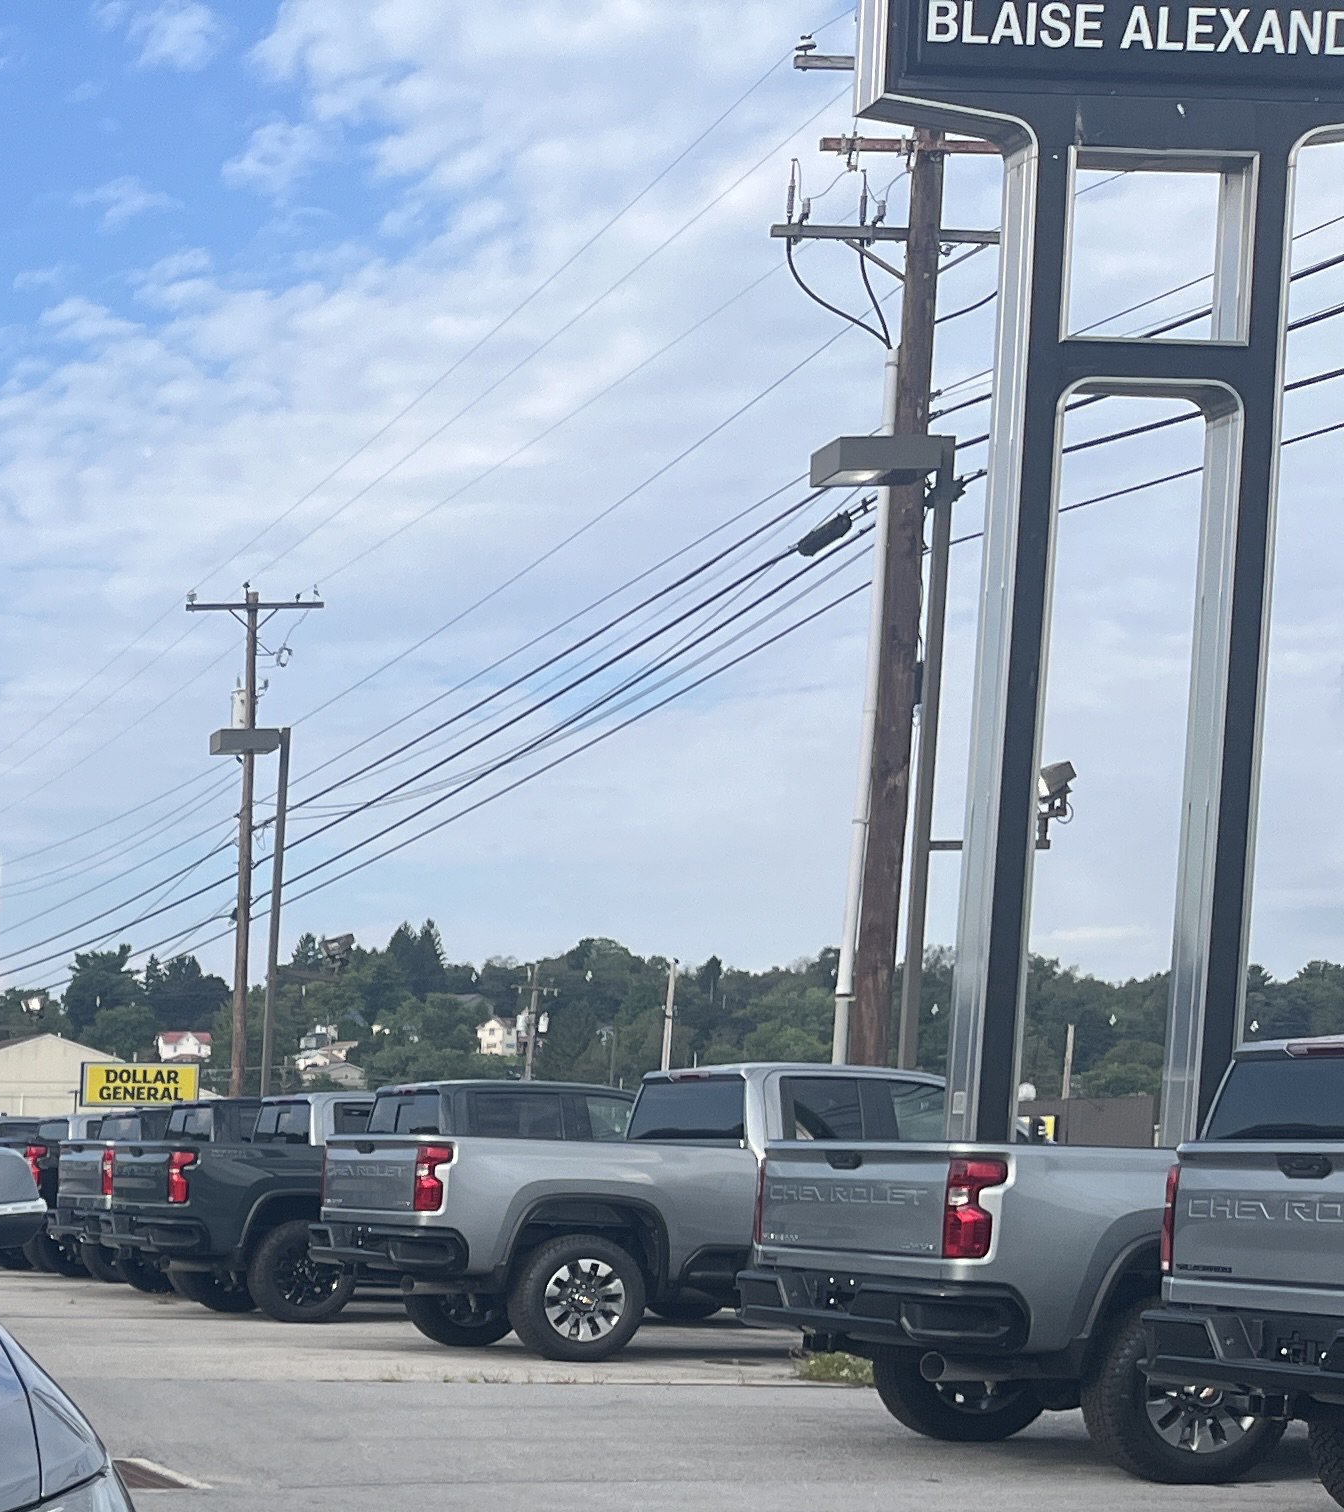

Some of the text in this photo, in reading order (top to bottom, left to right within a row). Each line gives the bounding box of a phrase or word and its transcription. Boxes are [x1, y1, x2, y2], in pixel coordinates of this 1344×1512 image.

[926, 0, 1105, 48] BLAISE
[105, 1069, 179, 1084] DOLLAR
[99, 1086, 184, 1101] GENERAL
[769, 1184, 928, 1206] CHEVROLET
[1188, 1198, 1344, 1223] CHEVRO
